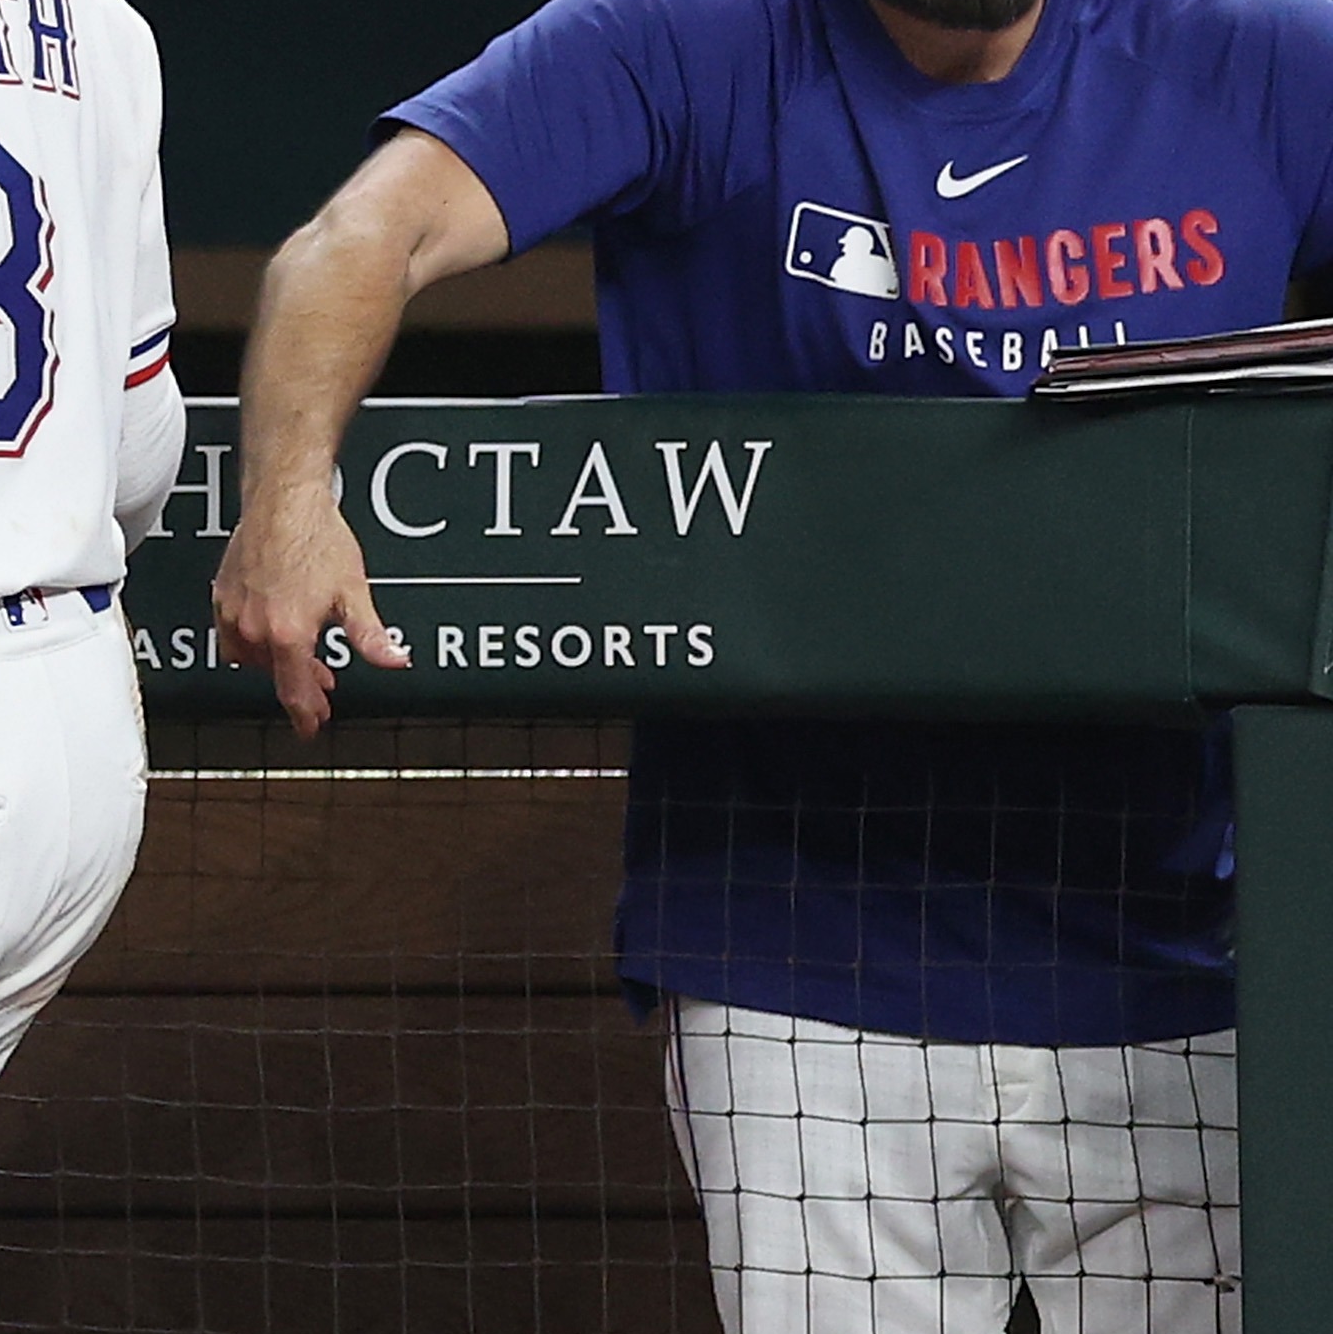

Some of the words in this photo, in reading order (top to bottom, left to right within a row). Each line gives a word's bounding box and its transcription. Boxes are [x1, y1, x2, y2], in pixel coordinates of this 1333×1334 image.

[907, 208, 1225, 310] RANGERS
[146, 441, 773, 538] HCTAW
[437, 624, 715, 668] RESORTS
